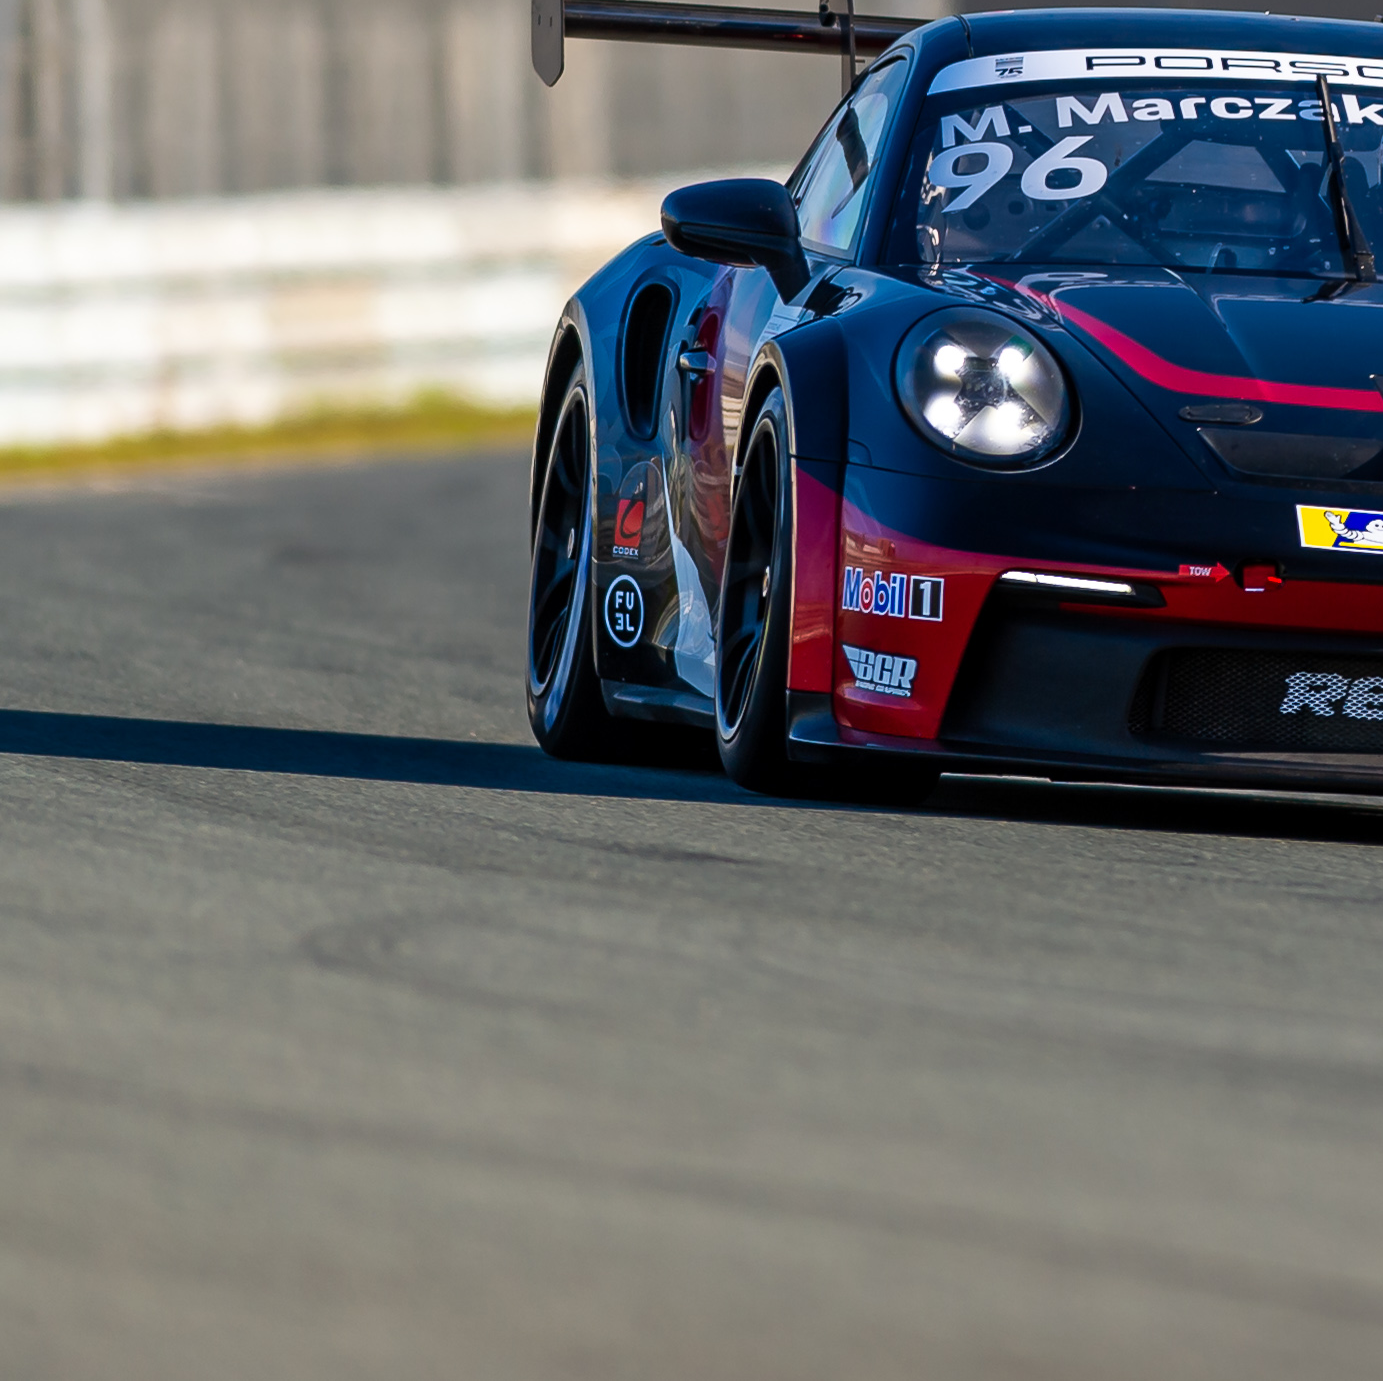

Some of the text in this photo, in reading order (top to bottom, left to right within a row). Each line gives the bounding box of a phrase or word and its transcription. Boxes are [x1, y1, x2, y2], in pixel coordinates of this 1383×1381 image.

[941, 104, 1034, 148] M.
[928, 135, 1108, 215] 96
[612, 545, 639, 556] CODEX
[1189, 566, 1212, 577] TOW
[615, 590, 635, 609] FU
[842, 566, 907, 618] Mobil
